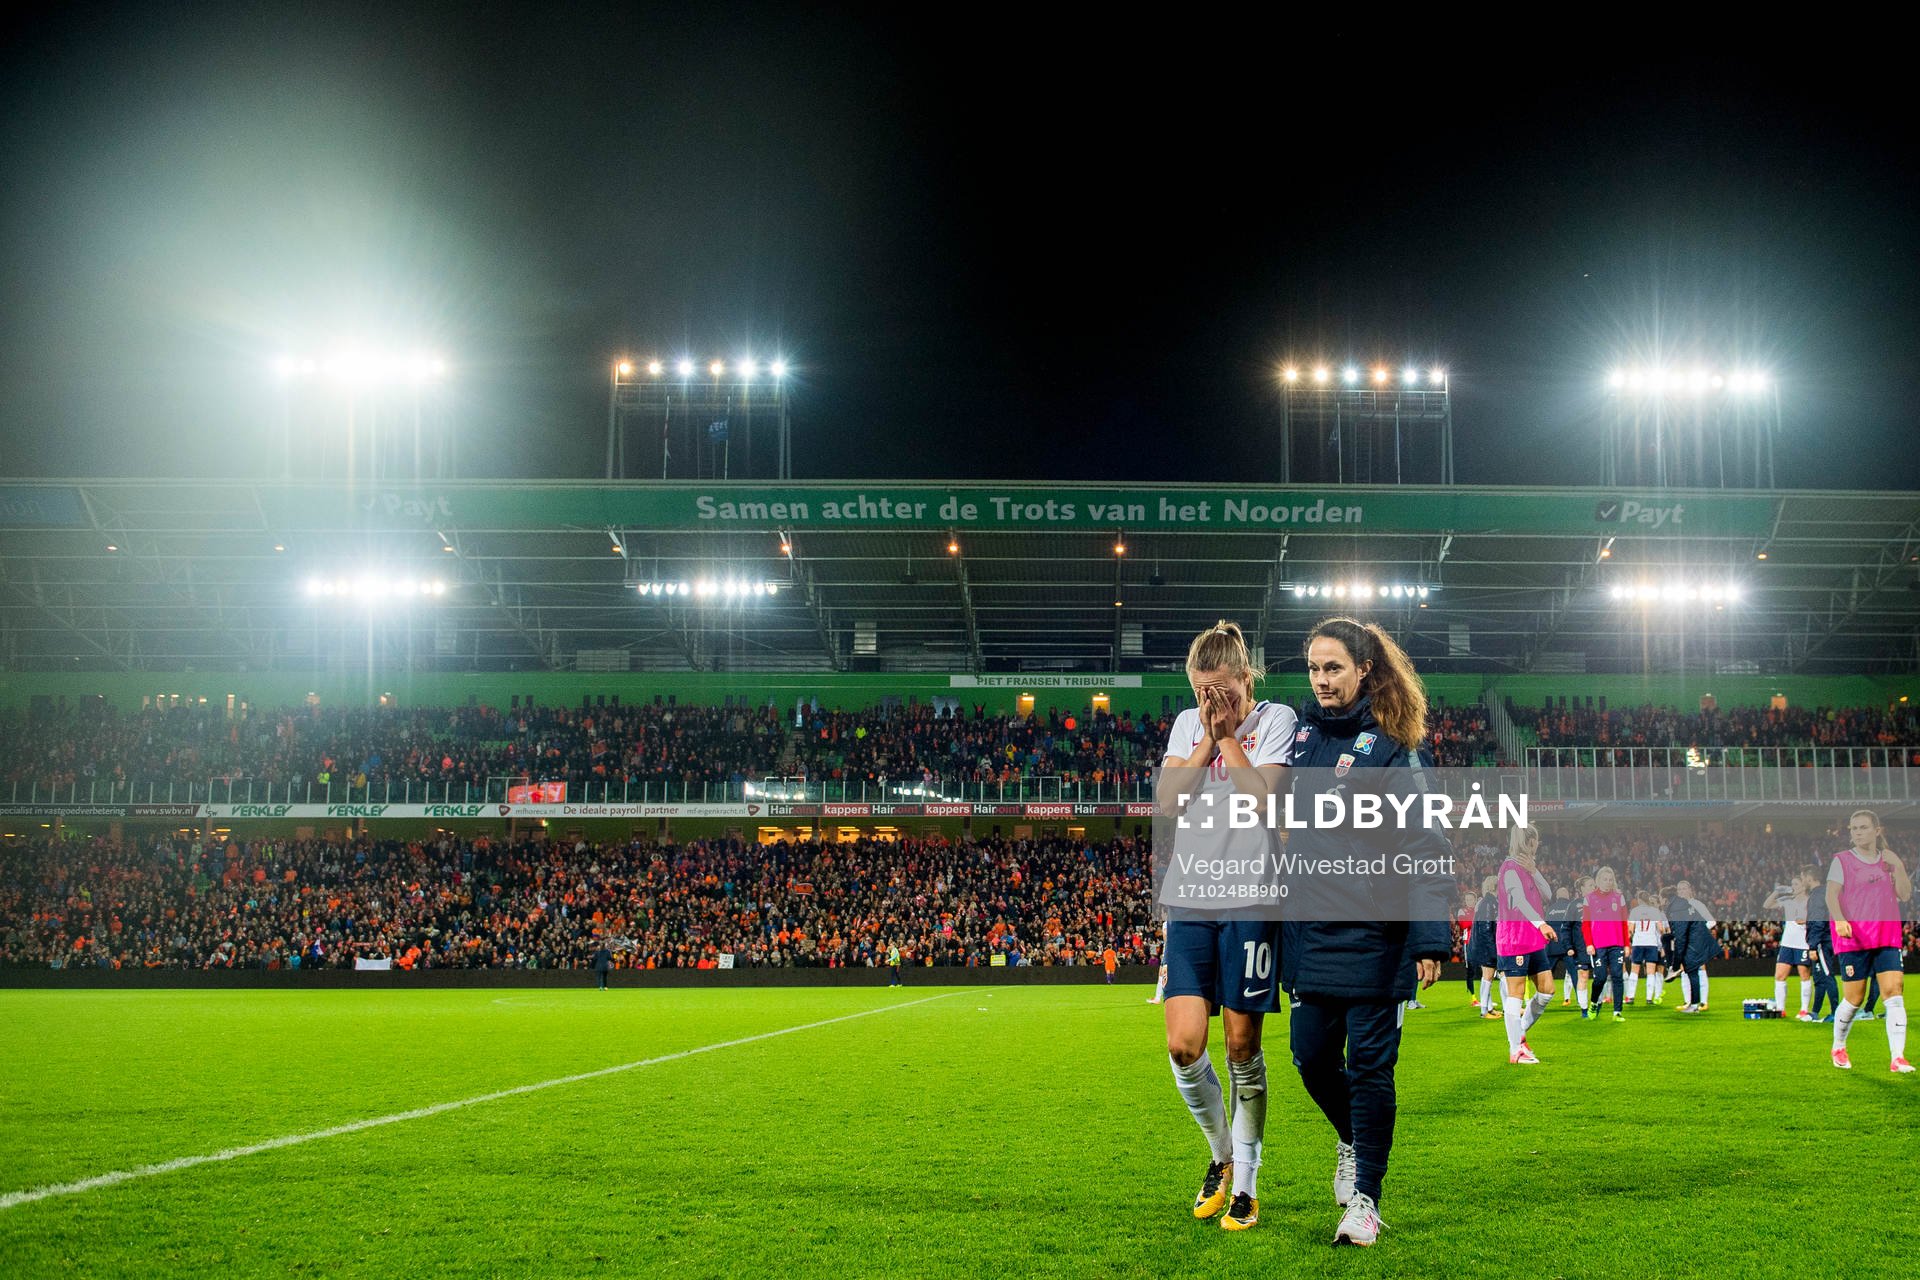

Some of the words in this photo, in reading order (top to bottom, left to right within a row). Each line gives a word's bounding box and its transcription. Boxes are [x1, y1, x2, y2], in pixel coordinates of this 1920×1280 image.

[382, 493, 453, 522] Payt
[696, 495, 809, 520] Samen
[822, 494, 927, 520] achter
[939, 496, 978, 521] de
[989, 496, 1076, 521] Trots
[1087, 503, 1145, 521] van
[1159, 497, 1211, 521] het
[1224, 498, 1363, 523] Noorden
[1619, 500, 1685, 529] Payt
[976, 677, 1002, 686] PIET
[1006, 677, 1062, 686] FRANSEN
[1064, 677, 1115, 686] TRIBUNE
[35, 807, 43, 815] in
[44, 806, 126, 817] vastgoedverbetering
[135, 806, 194, 815] www.swbv.nl
[231, 805, 293, 816] VERKLEY
[328, 805, 390, 816] VERKLEY
[424, 805, 486, 816] VERKLEY
[564, 805, 576, 815] De
[579, 805, 607, 815] ideale
[610, 805, 641, 817] payroll
[644, 806, 679, 817] partner
[824, 804, 869, 816] kappers
[926, 804, 970, 816] kappers
[1027, 804, 1071, 816] kappers
[1639, 918, 1651, 932] 17
[1243, 940, 1272, 980] 10
